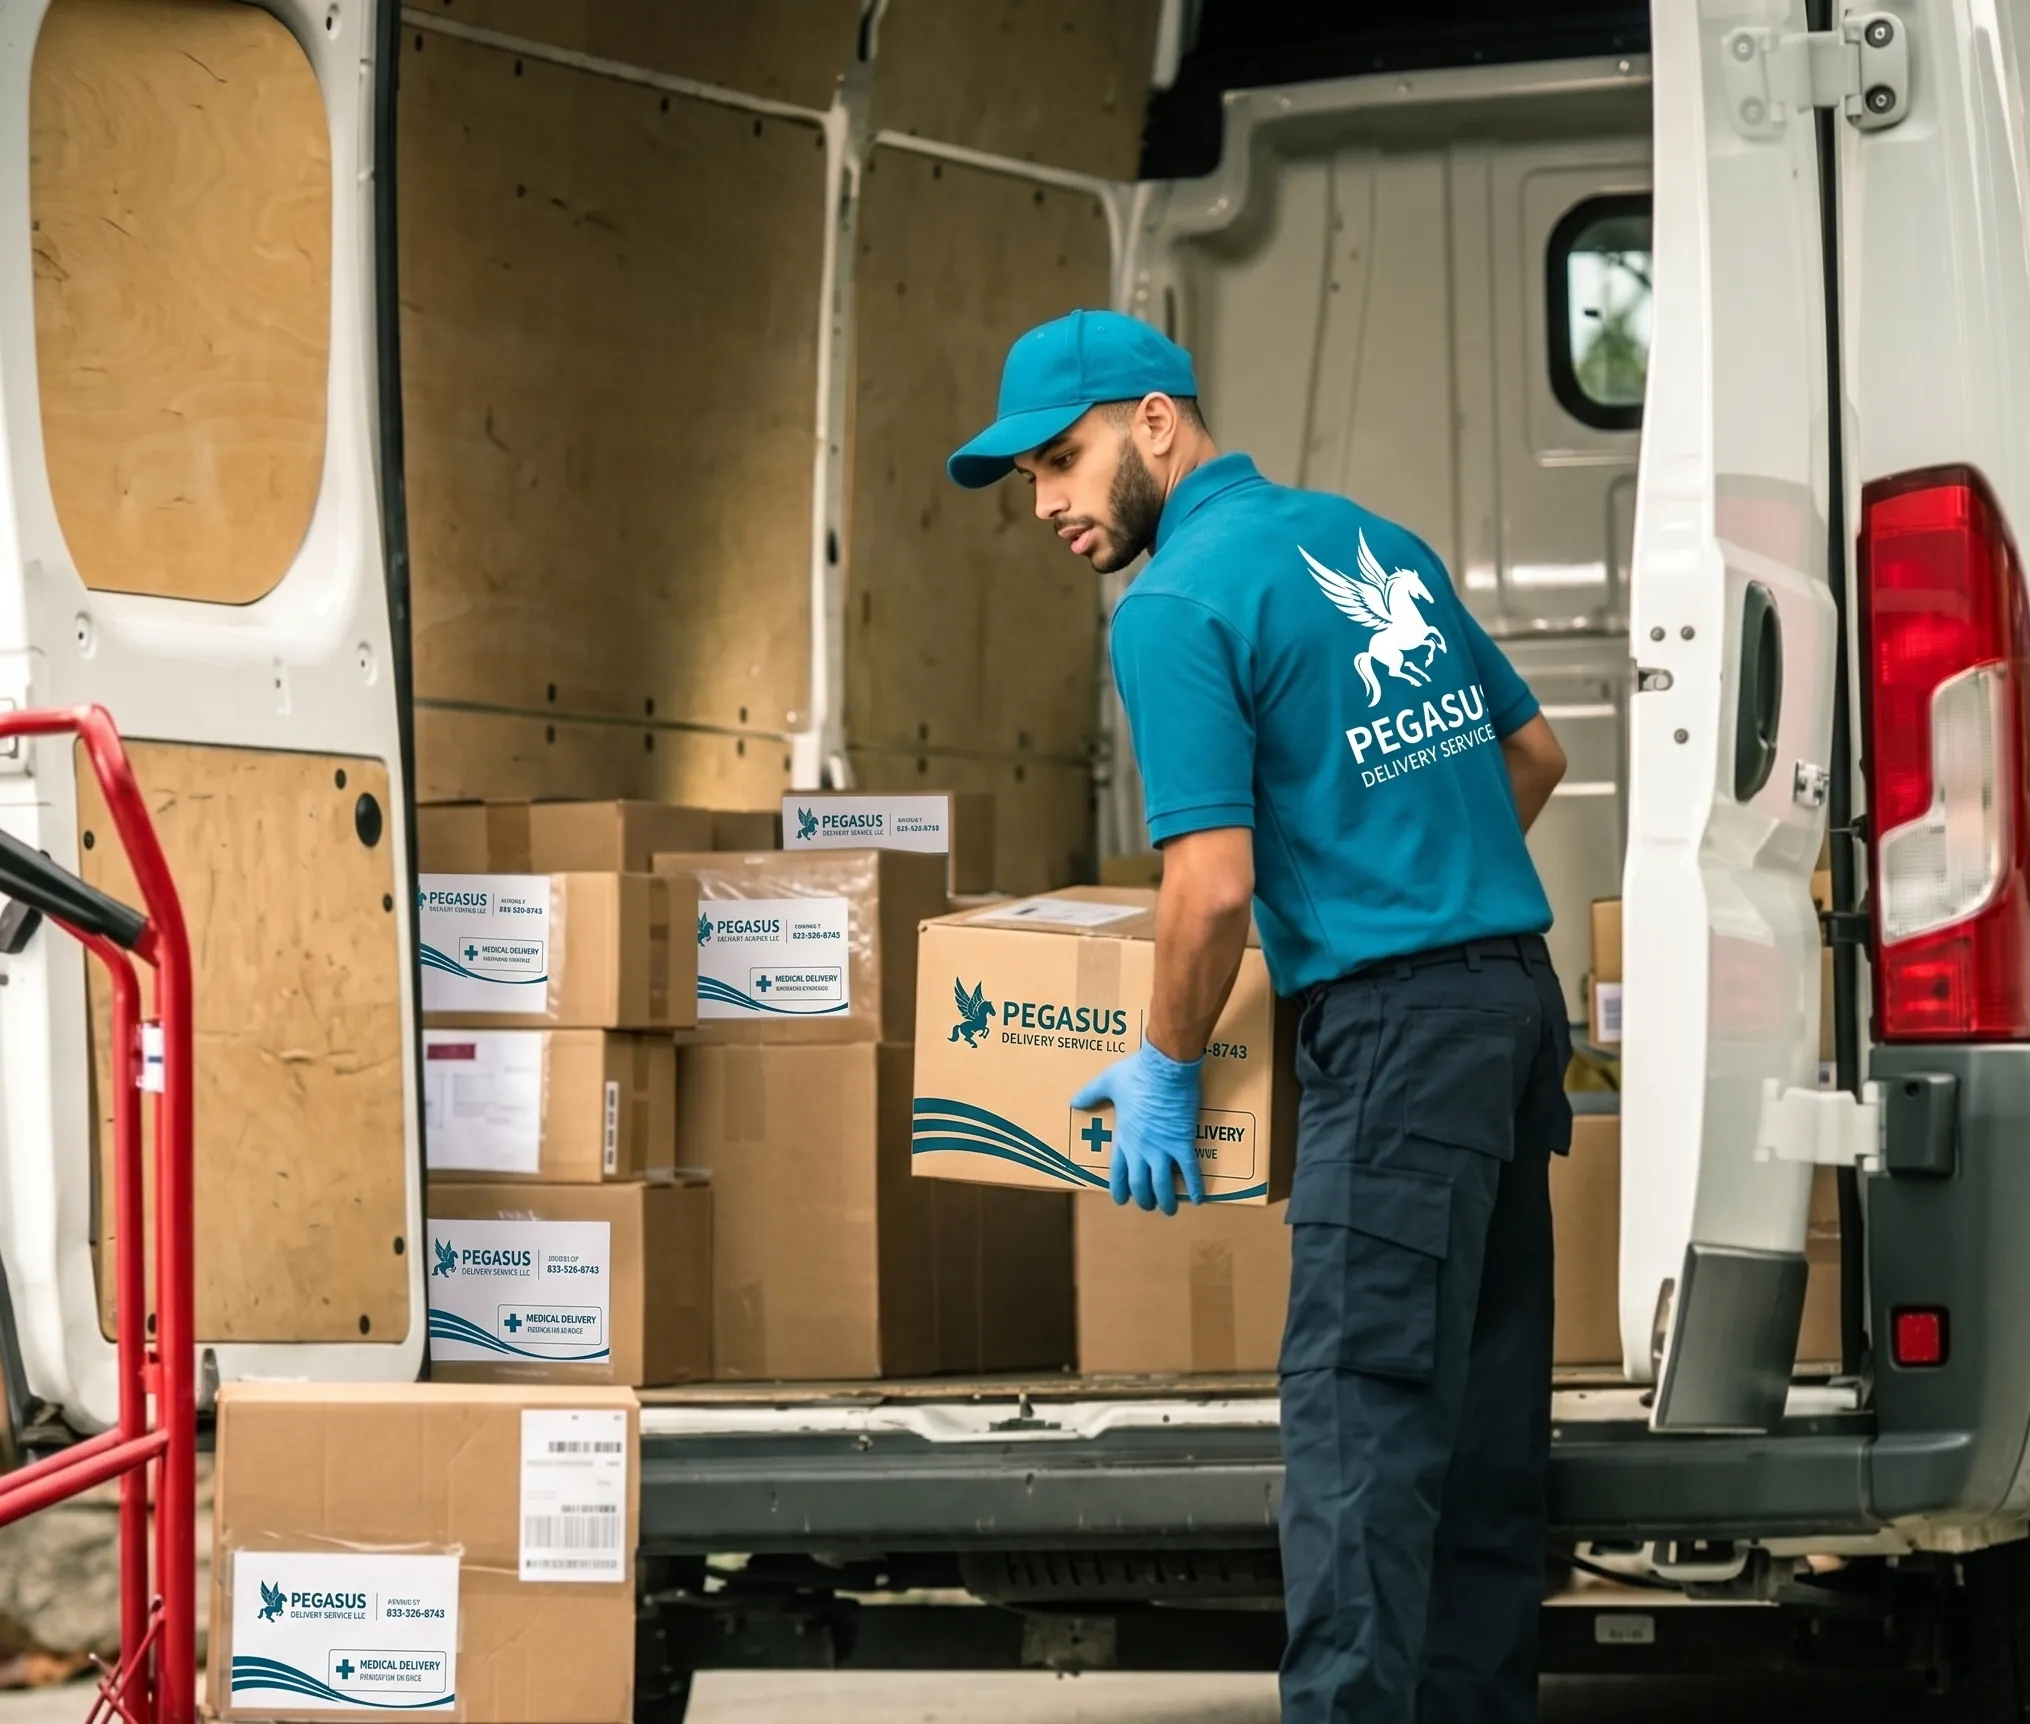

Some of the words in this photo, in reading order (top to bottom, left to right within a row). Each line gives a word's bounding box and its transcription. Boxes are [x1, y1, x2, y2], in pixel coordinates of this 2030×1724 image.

[1345, 683, 1489, 764] PEGASU
[1361, 745, 1437, 788] DELIVERY
[1440, 723, 1496, 758] SERVICE
[822, 814, 883, 828] PEGASUS
[429, 891, 487, 906] PEGASUS
[717, 919, 780, 934] PEGASUS
[482, 945, 509, 954] MEDICAL
[509, 947, 540, 955] DELIVERY
[775, 975, 805, 983] MEDICAL
[1003, 1001, 1127, 1035] PEGASUS
[1001, 1032, 1054, 1047] DELIVERY
[1057, 1036, 1103, 1051] SERVICE
[1106, 1041, 1125, 1053] LLC
[1196, 1124, 1245, 1142] LIVERY
[462, 1249, 531, 1266] PEGASUS
[519, 1269, 531, 1277] LLC
[526, 1314, 560, 1323] MEDICAL
[561, 1315, 597, 1324] DELIVERY
[291, 1592, 367, 1609] PEGASUS
[323, 1611, 352, 1620] SERVICE
[353, 1612, 366, 1620] LLC
[386, 1608, 445, 1618] 833-326-8743
[360, 1660, 398, 1670] MEDICAL
[399, 1660, 441, 1671] DELIVERY
